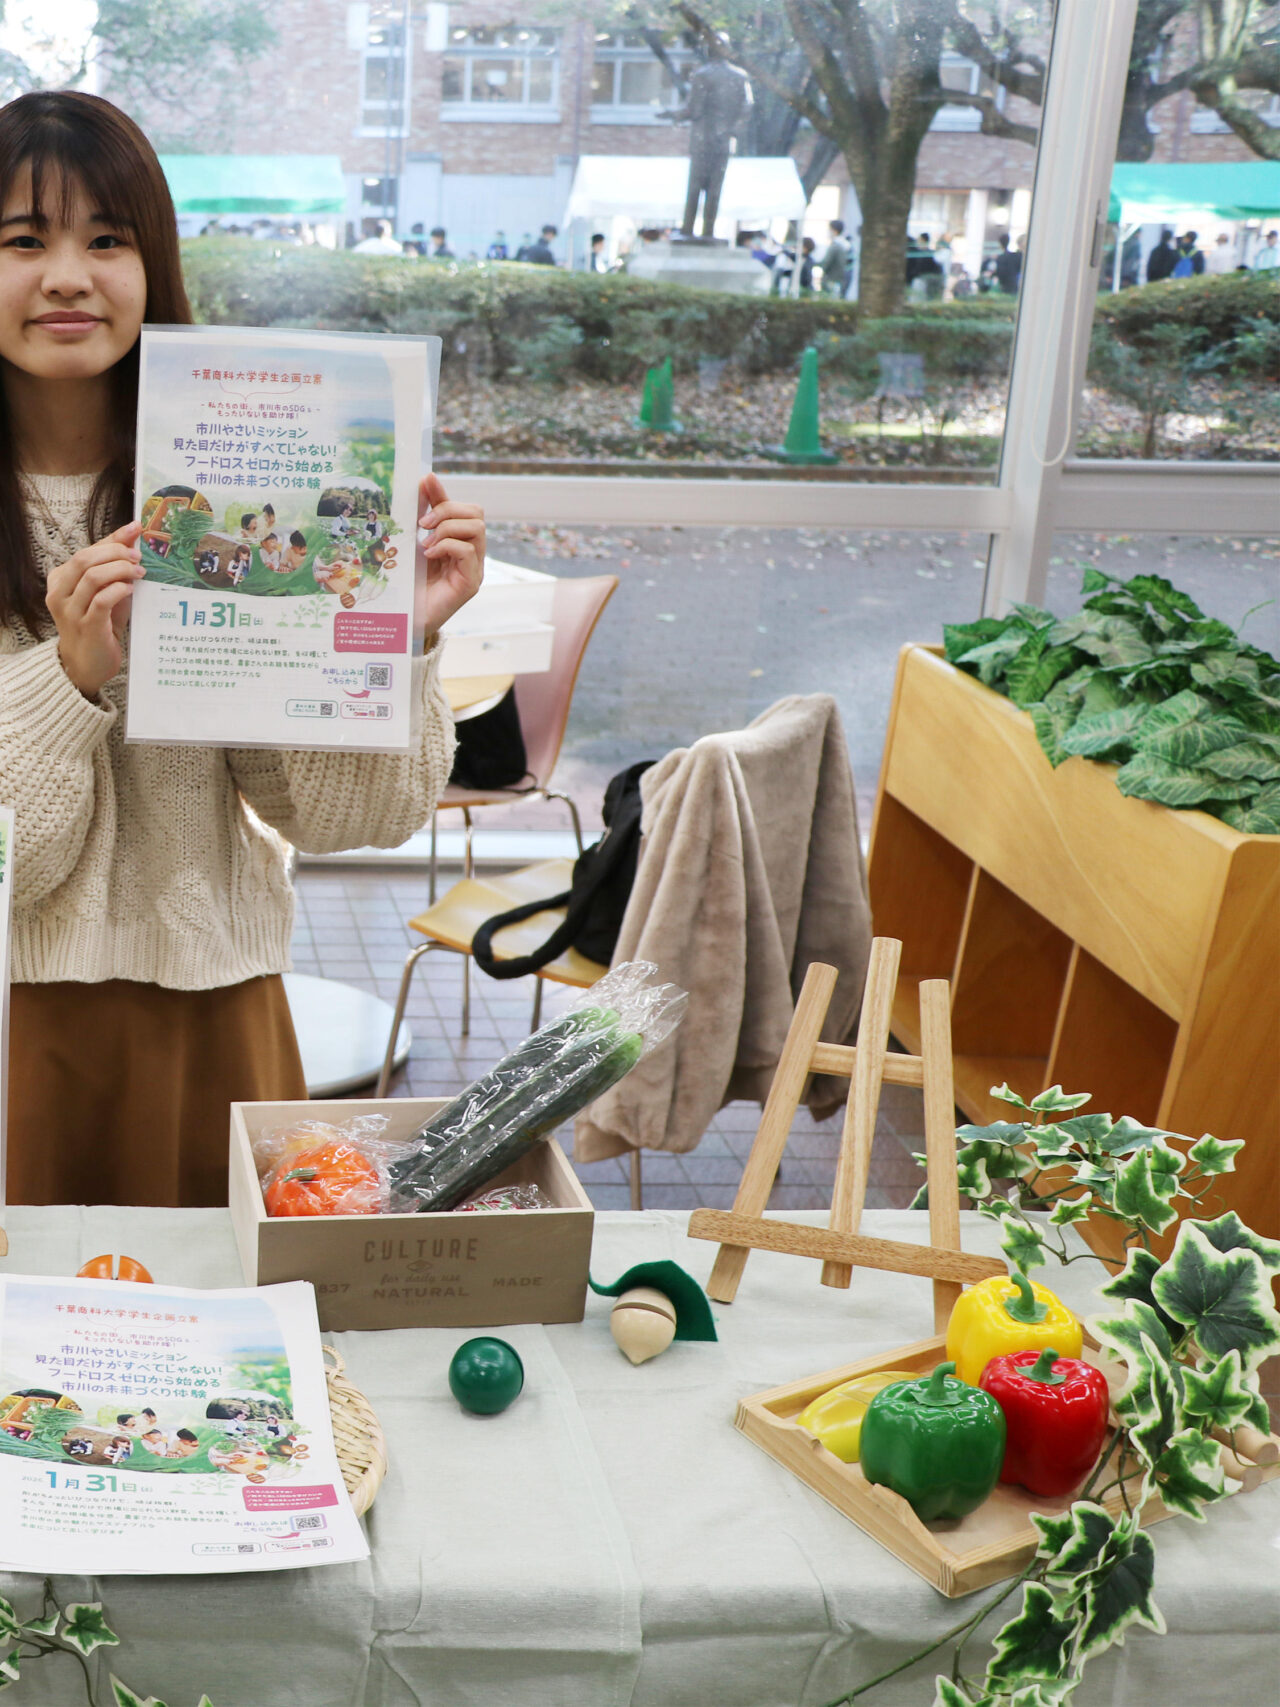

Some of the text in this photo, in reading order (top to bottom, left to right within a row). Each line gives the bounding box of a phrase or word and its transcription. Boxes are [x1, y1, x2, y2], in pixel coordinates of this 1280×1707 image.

[192, 369, 322, 385] 千葉商科大学学生企画立案
[196, 422, 308, 439] 市川やさいミッション
[196, 472, 321, 490] 市川の未来づくり体験
[364, 1238, 480, 1263] CULTURE
[492, 1276, 544, 1288] MADE
[372, 1286, 470, 1299] NATURAL
[60, 1344, 188, 1362] 市川やさいミッション
[61, 1381, 208, 1400] 市川の未来づくり体験
